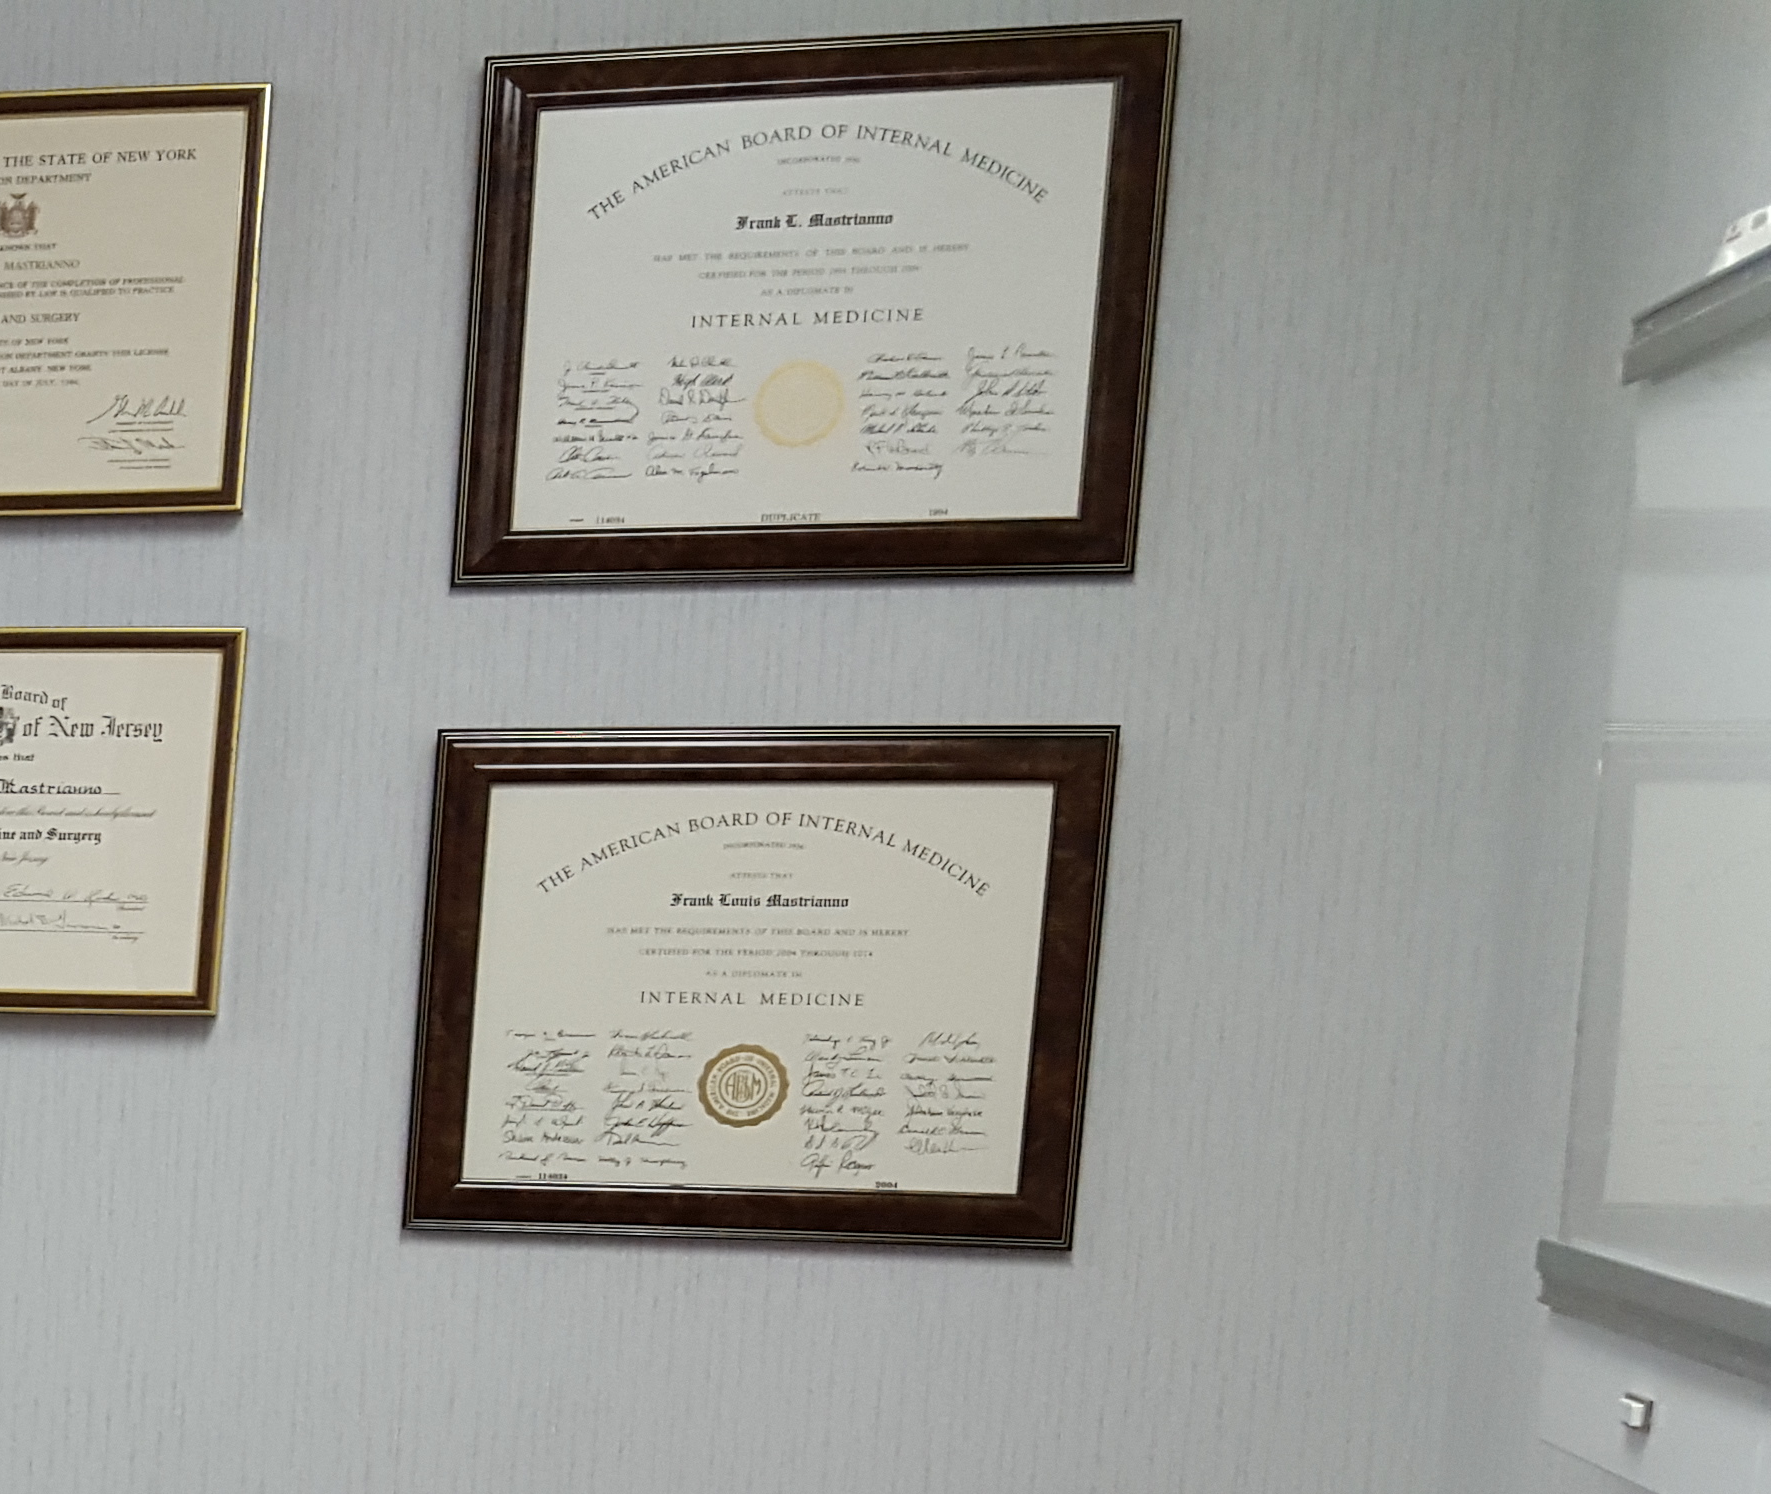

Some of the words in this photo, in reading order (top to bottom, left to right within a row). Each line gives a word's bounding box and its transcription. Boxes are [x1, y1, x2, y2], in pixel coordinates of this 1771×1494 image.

[3, 156, 33, 168] THE
[39, 153, 86, 166] STATE
[92, 152, 112, 164] OF
[117, 151, 150, 163] NEW
[155, 149, 196, 161] YORK
[16, 173, 91, 184] DEPARTMENT
[587, 190, 625, 220] THE
[632, 139, 731, 194] AMERICAN
[741, 125, 812, 150] BOARD
[821, 124, 848, 139] OF
[857, 125, 953, 157] INTERNAL
[961, 148, 1049, 204] MEDICINE
[735, 216, 780, 230] Frank
[808, 213, 894, 227] Mastrianno
[1, 313, 26, 324] AND
[692, 312, 802, 328] INTERNAL
[813, 308, 924, 325] MEDICINE
[761, 512, 820, 522] DUPLICATE
[0, 684, 48, 704] Board
[52, 697, 68, 711] of
[22, 716, 43, 737] of
[48, 715, 94, 737] New
[101, 715, 163, 742] Jersey
[19, 828, 42, 840] and
[45, 827, 102, 845] Surgery
[536, 865, 575, 893] THE
[581, 822, 681, 871] AMERICAN
[689, 812, 758, 832] BOARD
[766, 812, 792, 826] OF
[799, 814, 896, 847] INTERNAL
[902, 839, 991, 897] MEDICINE
[670, 893, 713, 907] Frank
[719, 893, 761, 907] Louis
[766, 894, 849, 907] Mastrianno
[640, 991, 746, 1005] INTERNAL
[760, 992, 865, 1007] MEDICINE
